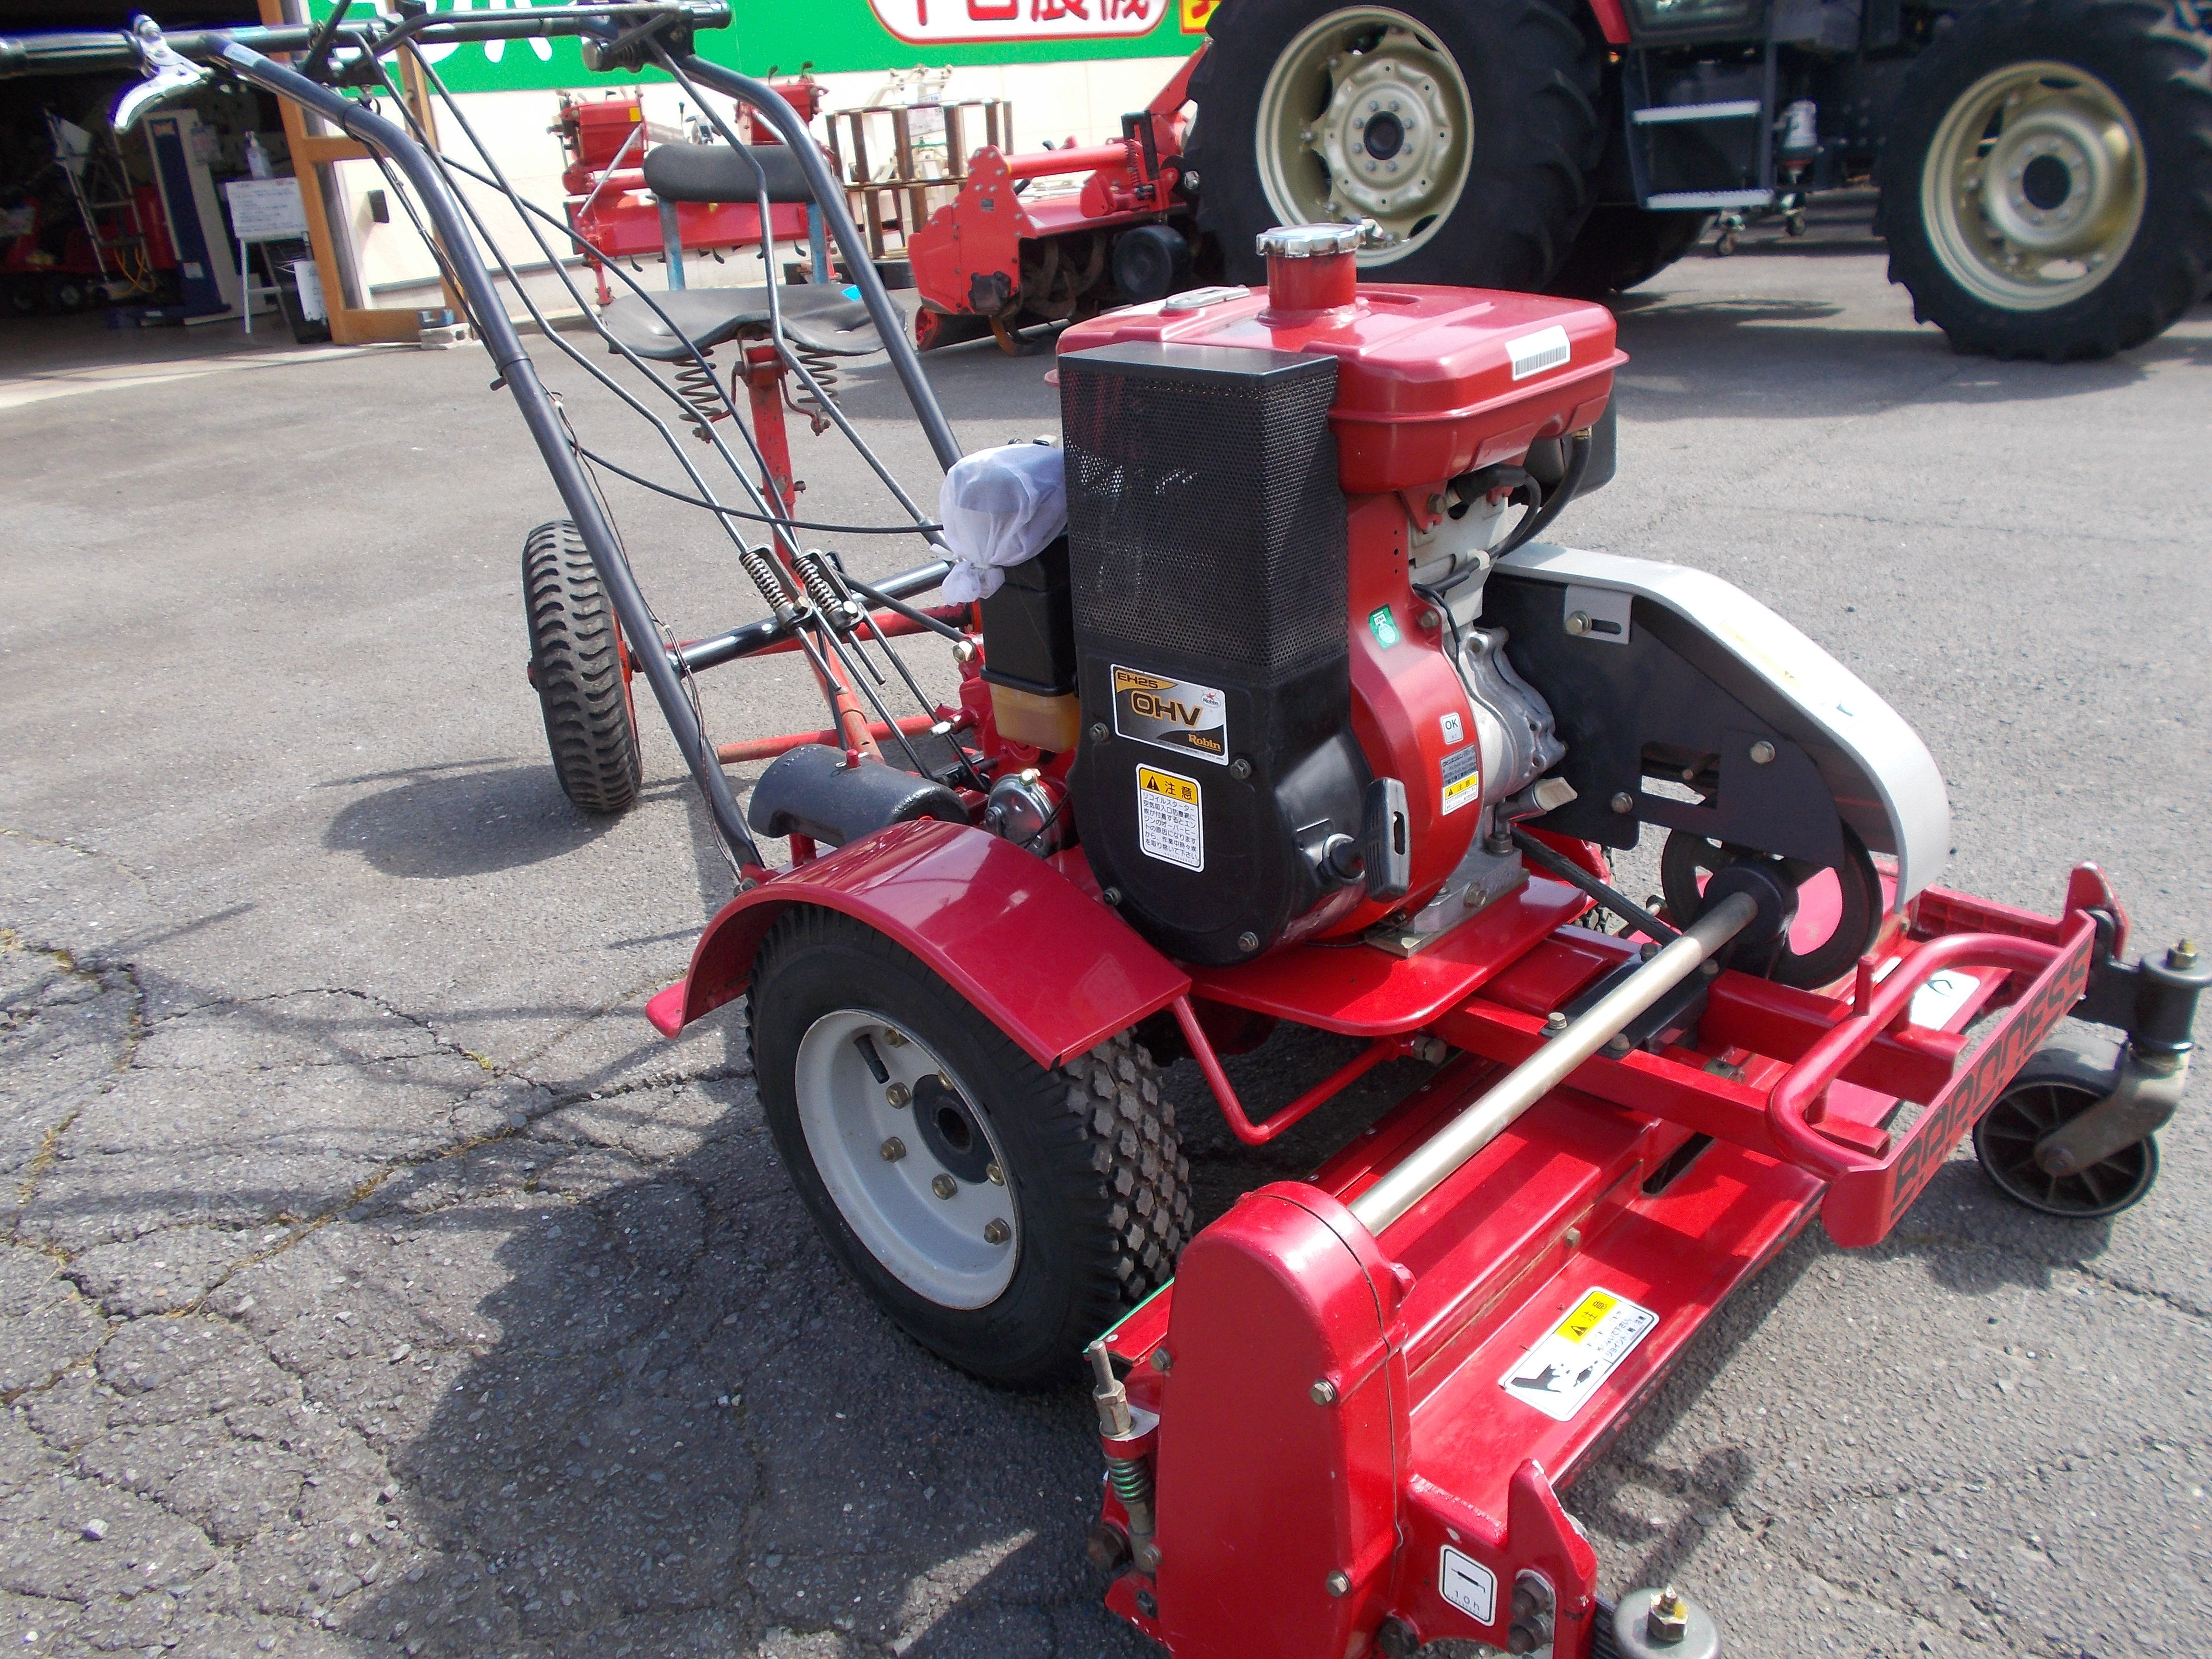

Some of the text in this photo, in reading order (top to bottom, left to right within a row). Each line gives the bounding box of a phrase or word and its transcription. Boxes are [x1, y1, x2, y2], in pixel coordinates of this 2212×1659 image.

[1118, 673, 1158, 688] EH25
[1131, 690, 1203, 728] OHV
[1203, 697, 1219, 706] Robin
[1445, 718, 1458, 730] OK
[1188, 733, 1222, 752] Robin
[1164, 780, 1193, 800] 注意
[1457, 780, 1471, 792] 注意
[1143, 792, 1195, 811] リコイルスターター
[1144, 816, 1197, 835] ジンのオーバーヒー
[1145, 823, 1196, 844] トの原因になります
[1145, 838, 1200, 862] を取り除いて下さい。
[1581, 1300, 1608, 1322] 注意
[1455, 1590, 1480, 1611] 10h
